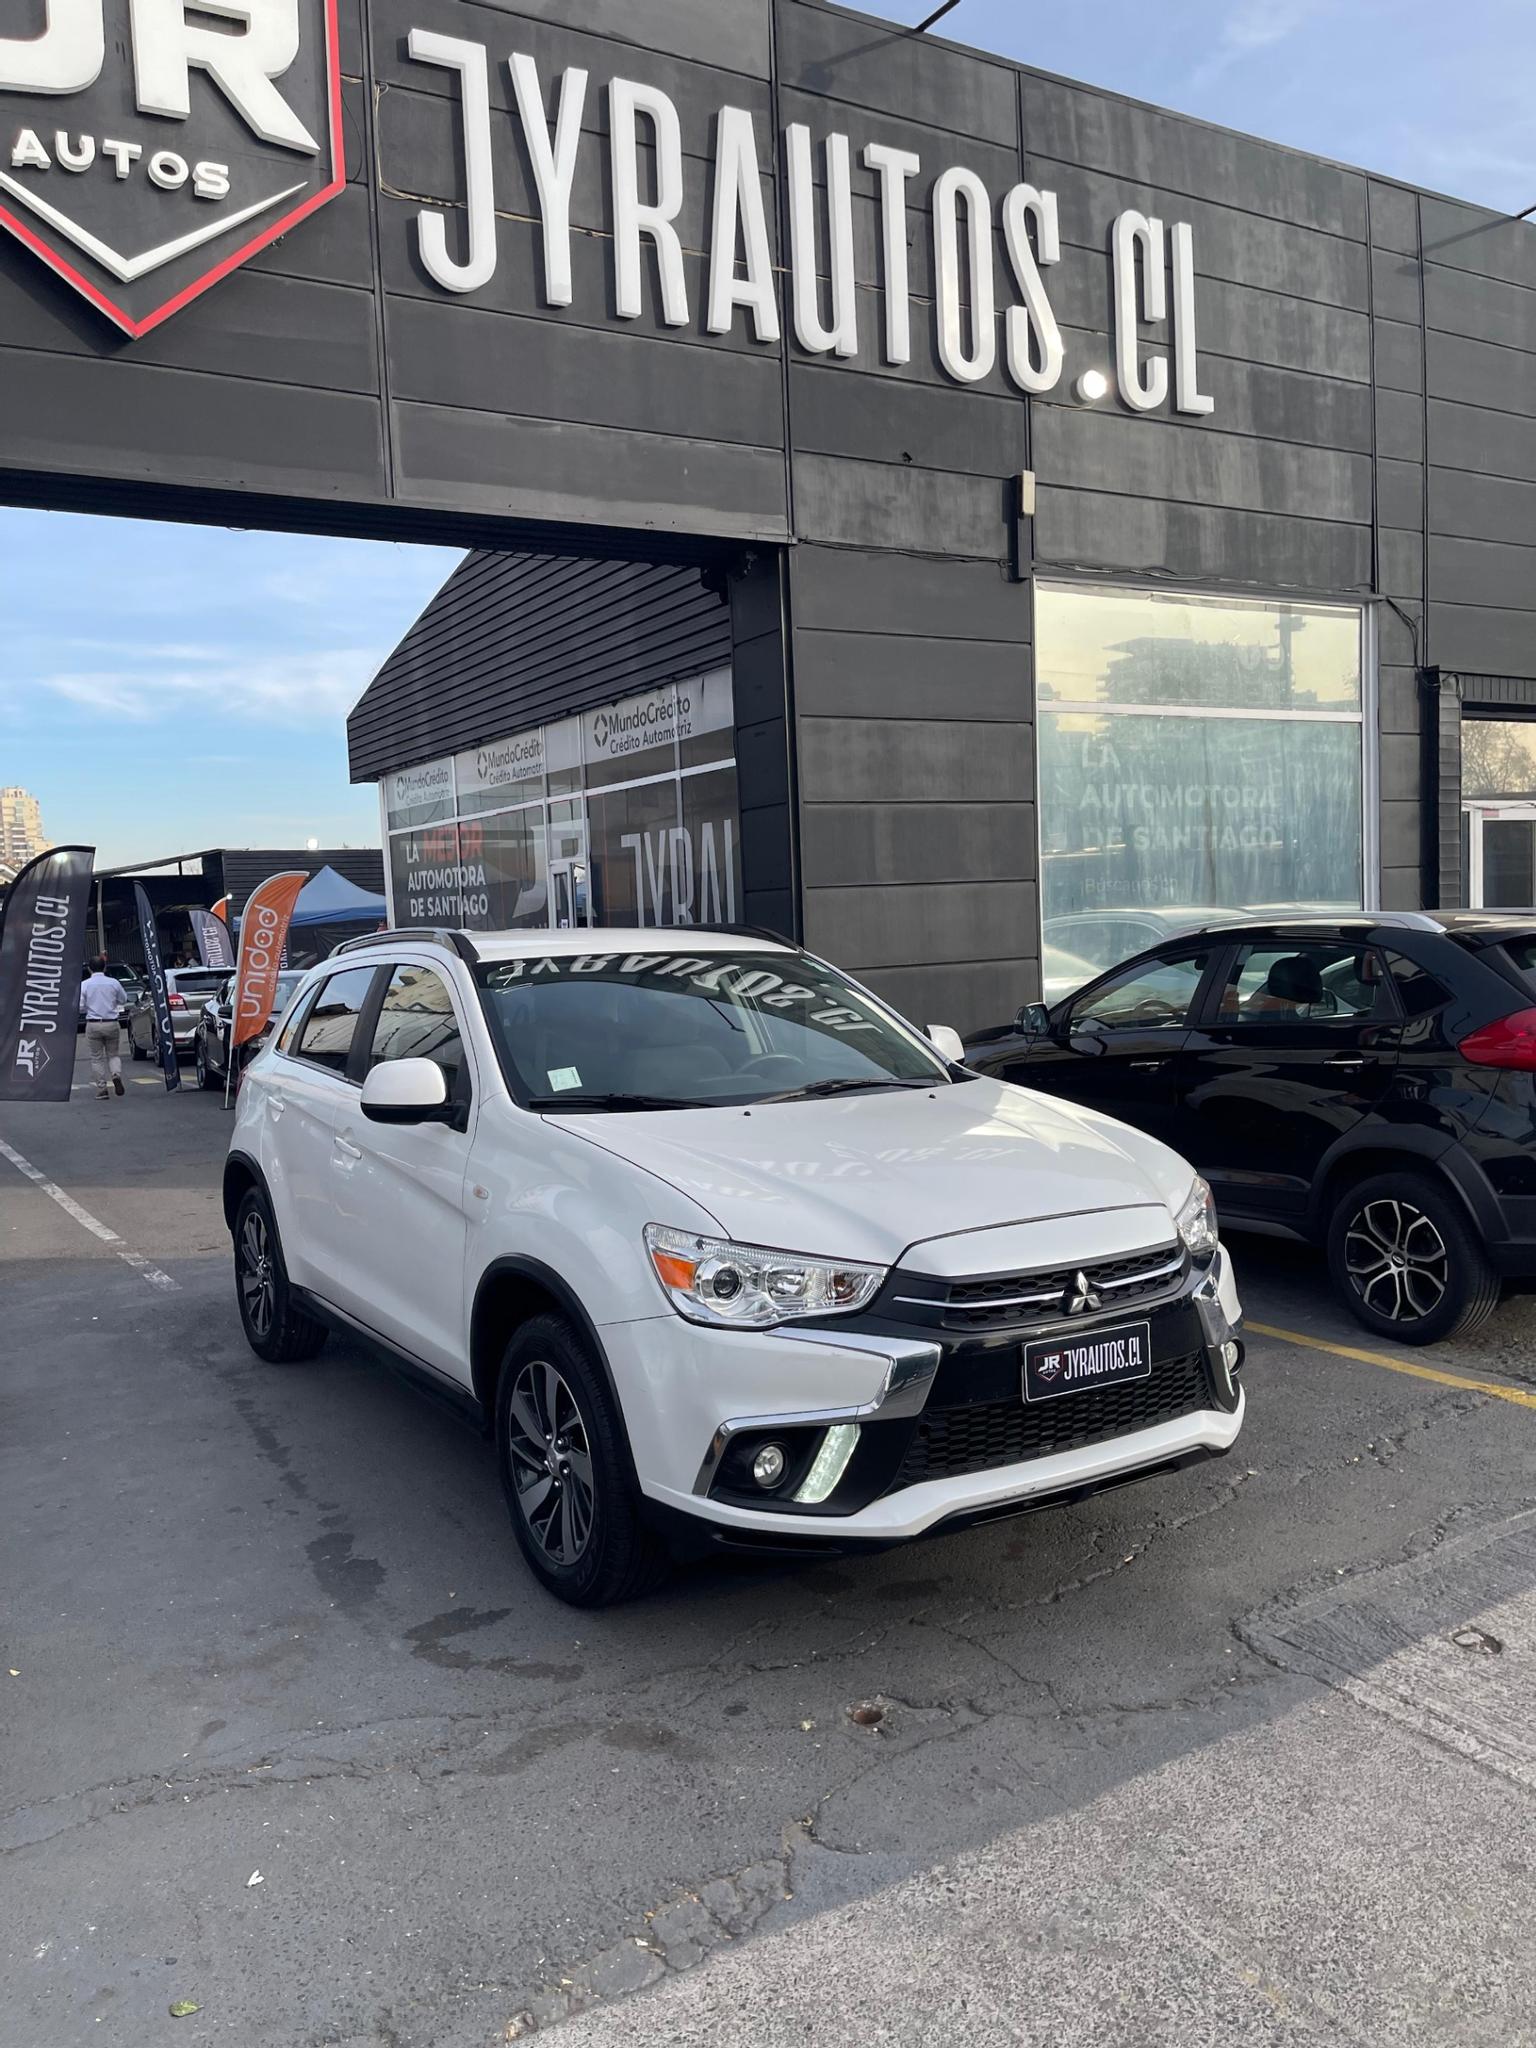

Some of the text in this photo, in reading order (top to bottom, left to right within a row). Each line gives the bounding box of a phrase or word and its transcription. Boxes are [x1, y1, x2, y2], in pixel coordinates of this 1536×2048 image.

[11, 129, 231, 200] AUTOS
[408, 28, 1214, 414] JYRAUTOS.CL
[610, 719, 692, 754] Crédito Automotriz
[1081, 738, 1121, 768] LA
[1079, 782, 1279, 809] AUTOMOTORA
[406, 820, 484, 864] LA MEJOR
[1082, 826, 1279, 850] DE SANTIAGO
[408, 864, 487, 893] AUTOMOTORA
[620, 818, 736, 928] JYRA
[411, 893, 489, 917] DE SANTIAGO
[19, 894, 71, 1033] JYRAUTOS.CL
[241, 904, 278, 1017] unidad
[16, 1039, 38, 1077] JR
[1038, 1336, 1143, 1381] JR JYRAUTOS.CL
